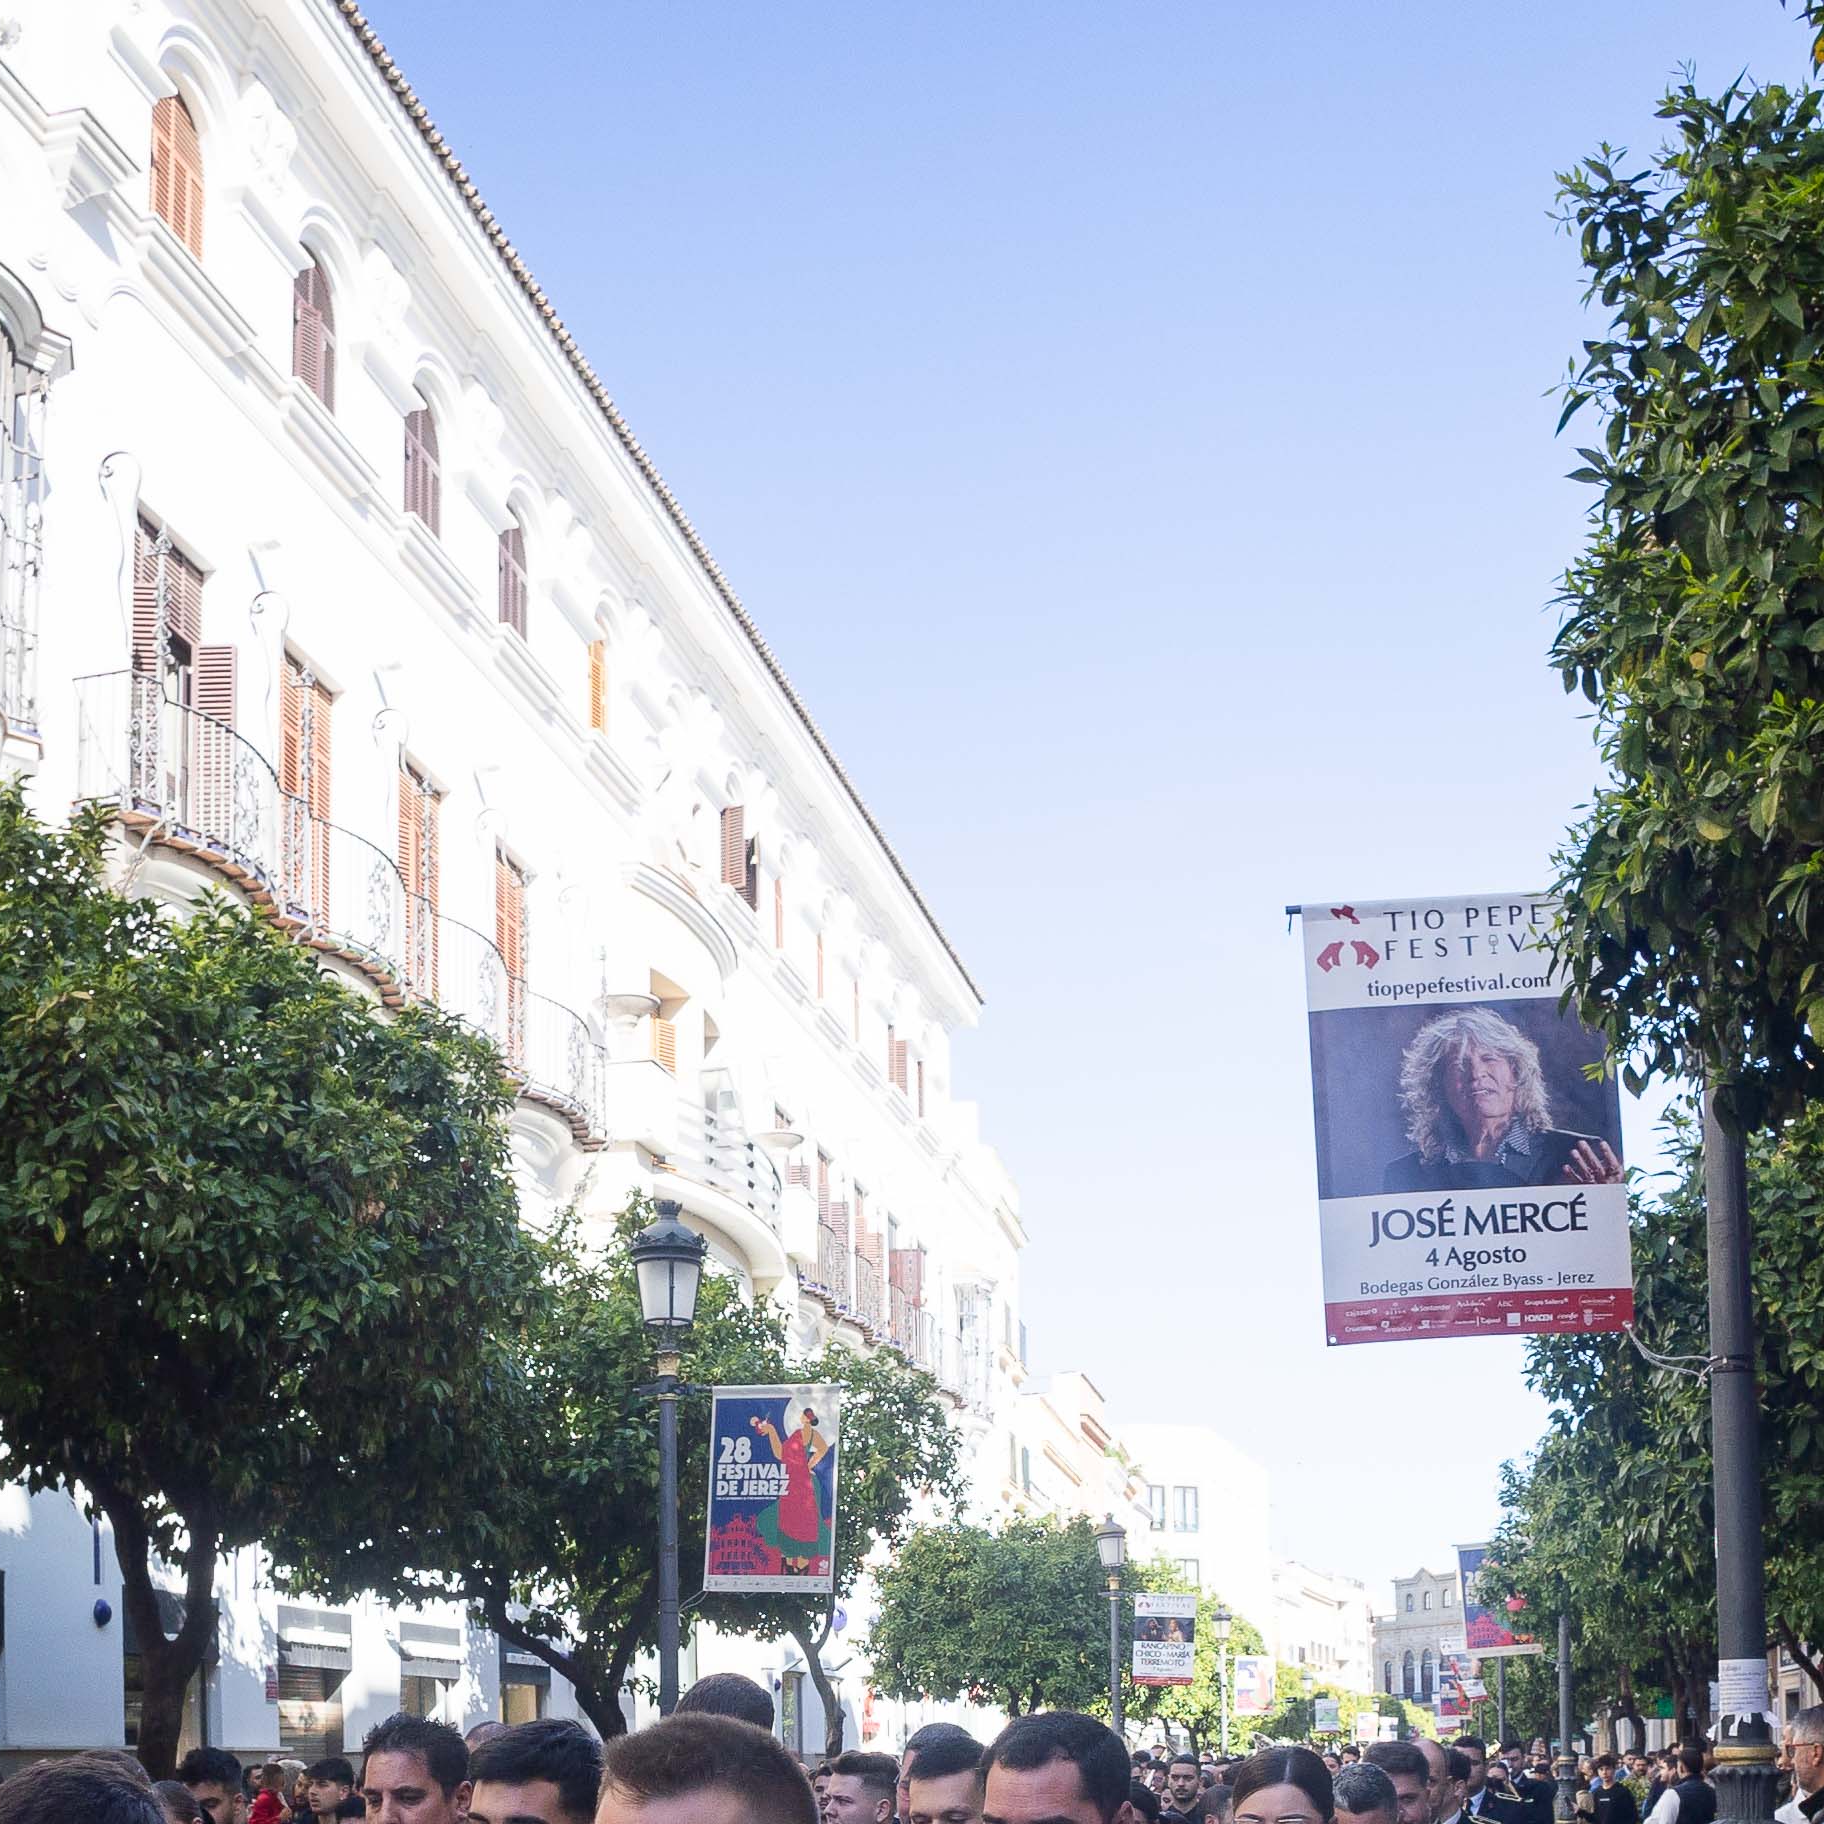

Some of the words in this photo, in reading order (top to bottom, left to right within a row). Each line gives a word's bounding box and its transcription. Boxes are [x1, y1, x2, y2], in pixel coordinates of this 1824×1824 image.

[1383, 909, 1444, 932] TIO
[1465, 904, 1546, 928] PEPE
[1367, 973, 1551, 1000] tiopepefestival.com
[1368, 1198, 1457, 1248] JOSÉ
[1463, 1192, 1589, 1236] MERCÉ
[1425, 1248, 1440, 1267] 4
[1444, 1246, 1527, 1271] Agosto
[1360, 1280, 1424, 1296] Bodegas
[1428, 1273, 1499, 1290] González
[1503, 1273, 1544, 1289] Byass
[1557, 1271, 1595, 1285] Jerez
[718, 1436, 752, 1463] 28
[717, 1463, 790, 1480] FESTIVAL
[716, 1480, 739, 1496] DE
[740, 1480, 790, 1496] JEREZ
